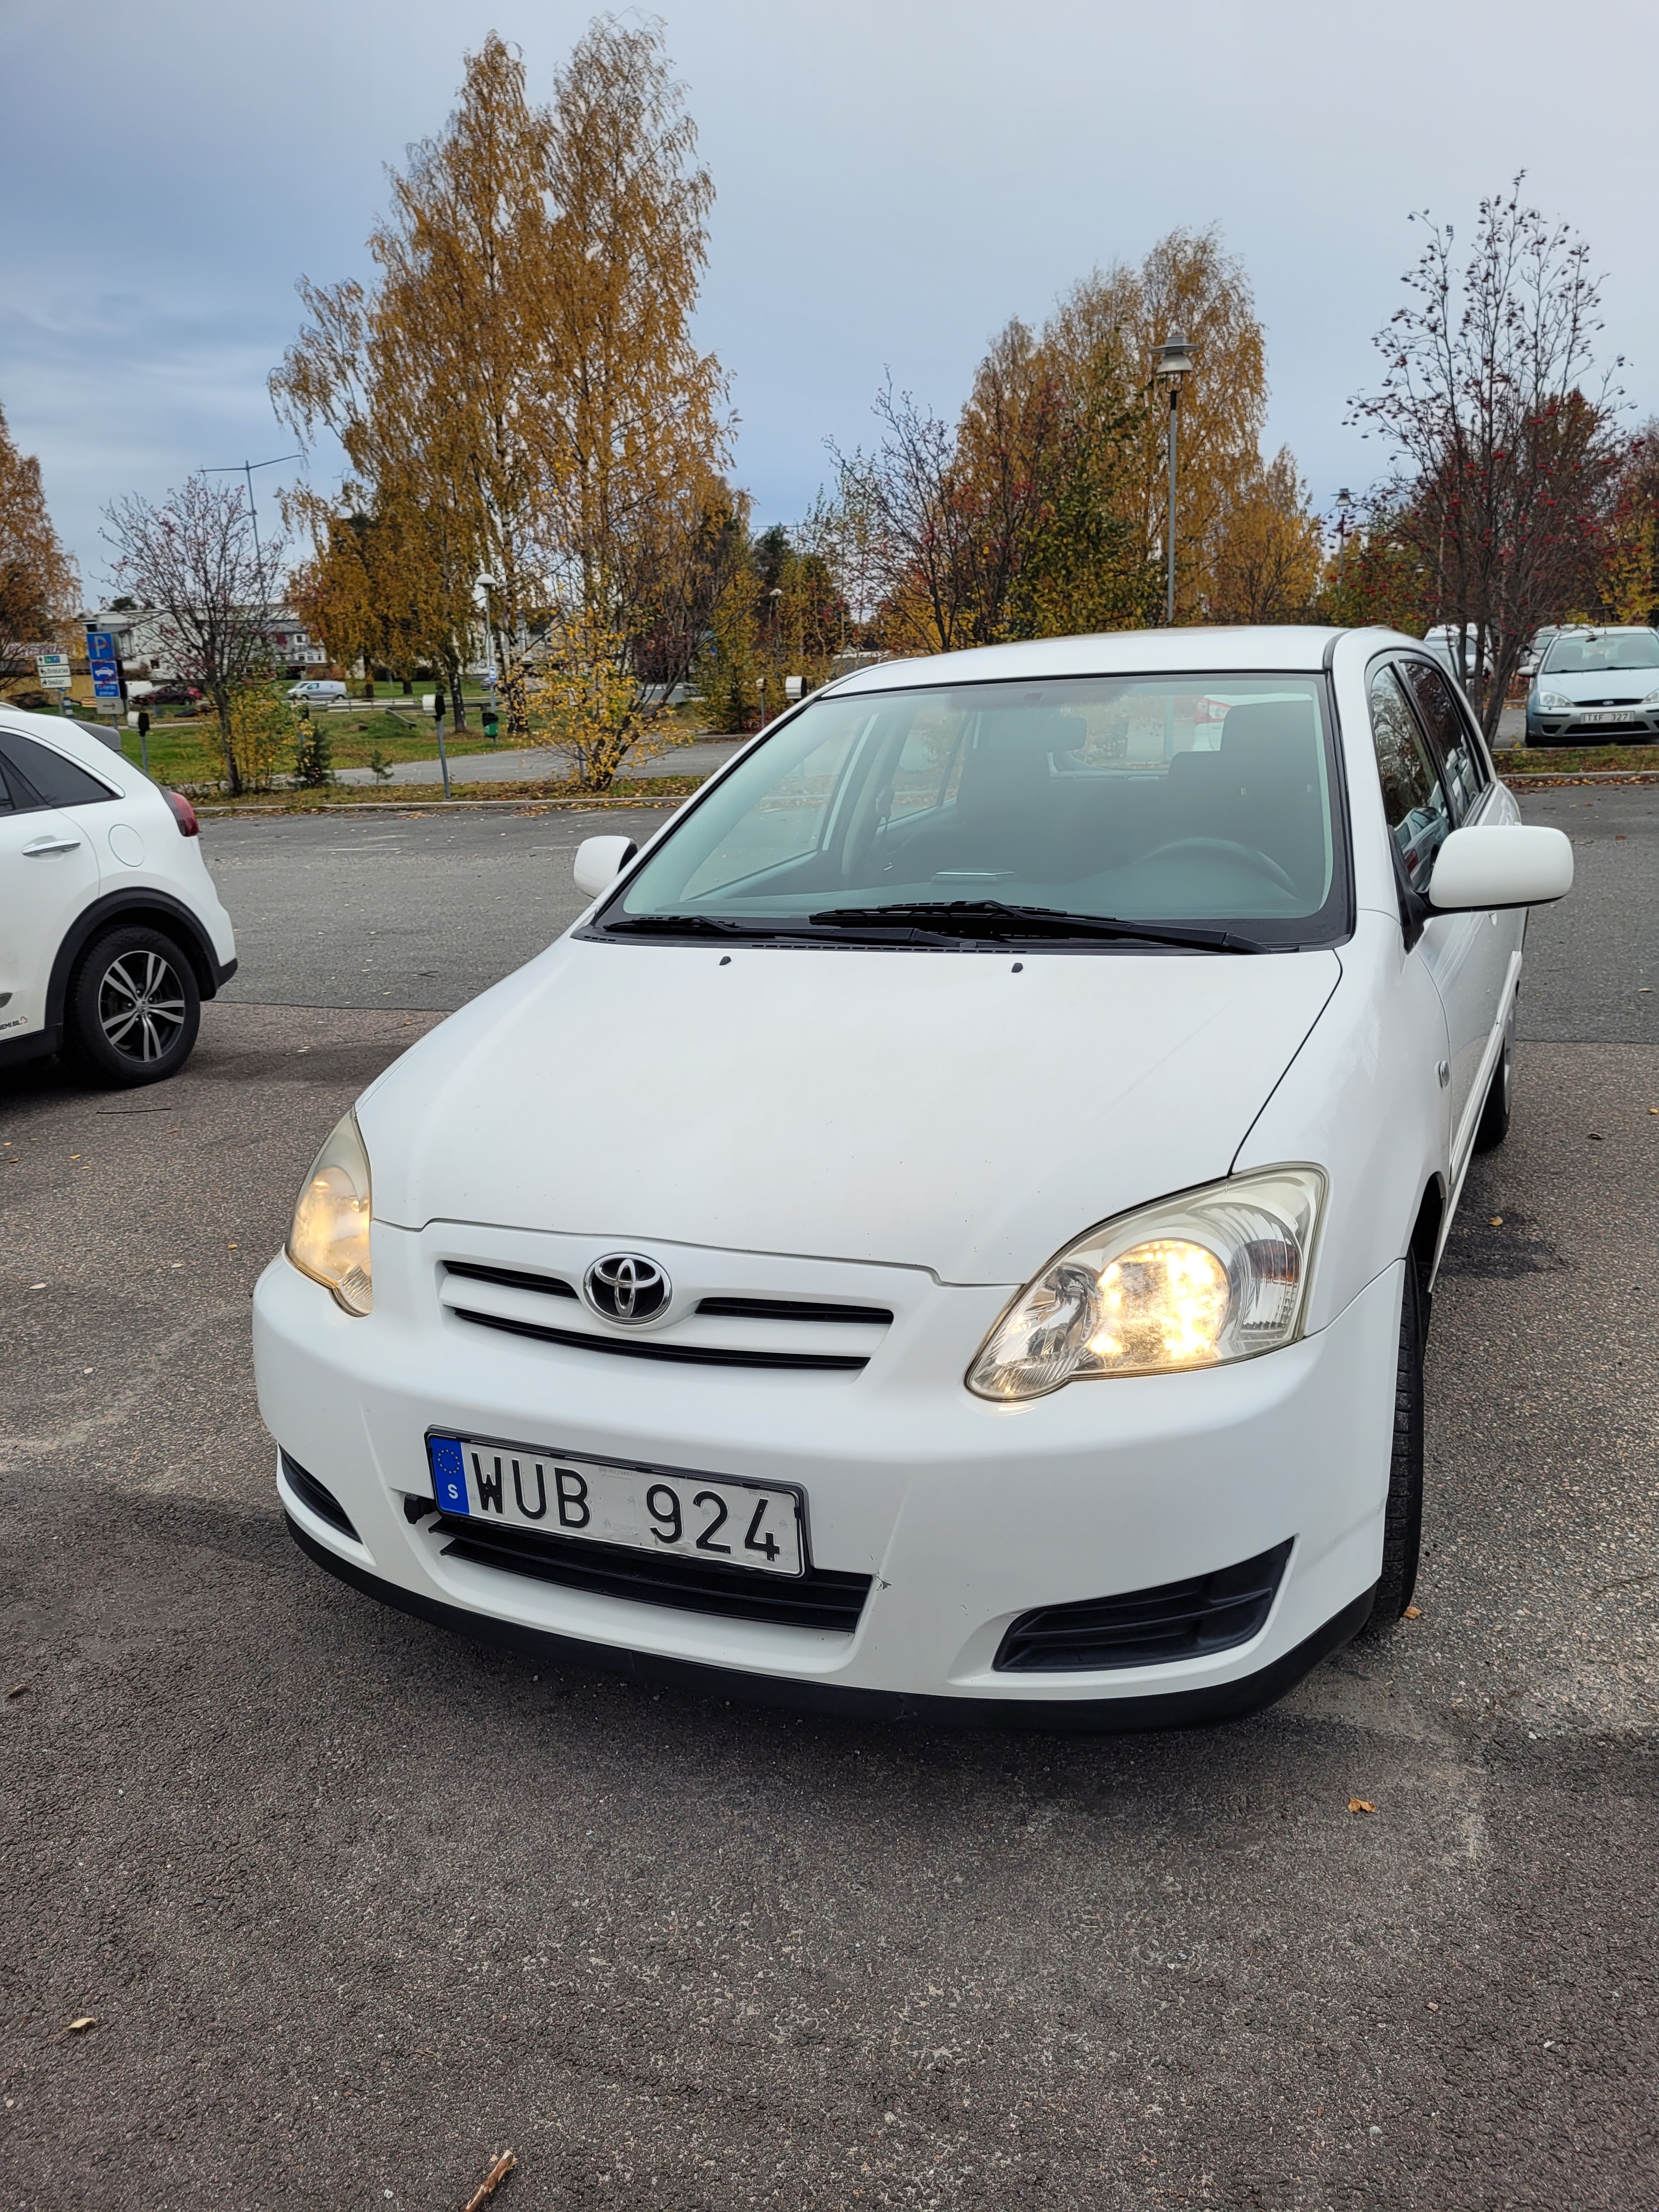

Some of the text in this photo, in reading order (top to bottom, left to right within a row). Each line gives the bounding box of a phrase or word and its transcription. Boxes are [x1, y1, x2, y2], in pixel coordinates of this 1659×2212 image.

[94, 635, 108, 658] P
[447, 1483, 459, 1499] S
[471, 1452, 780, 1561] WUB 924
